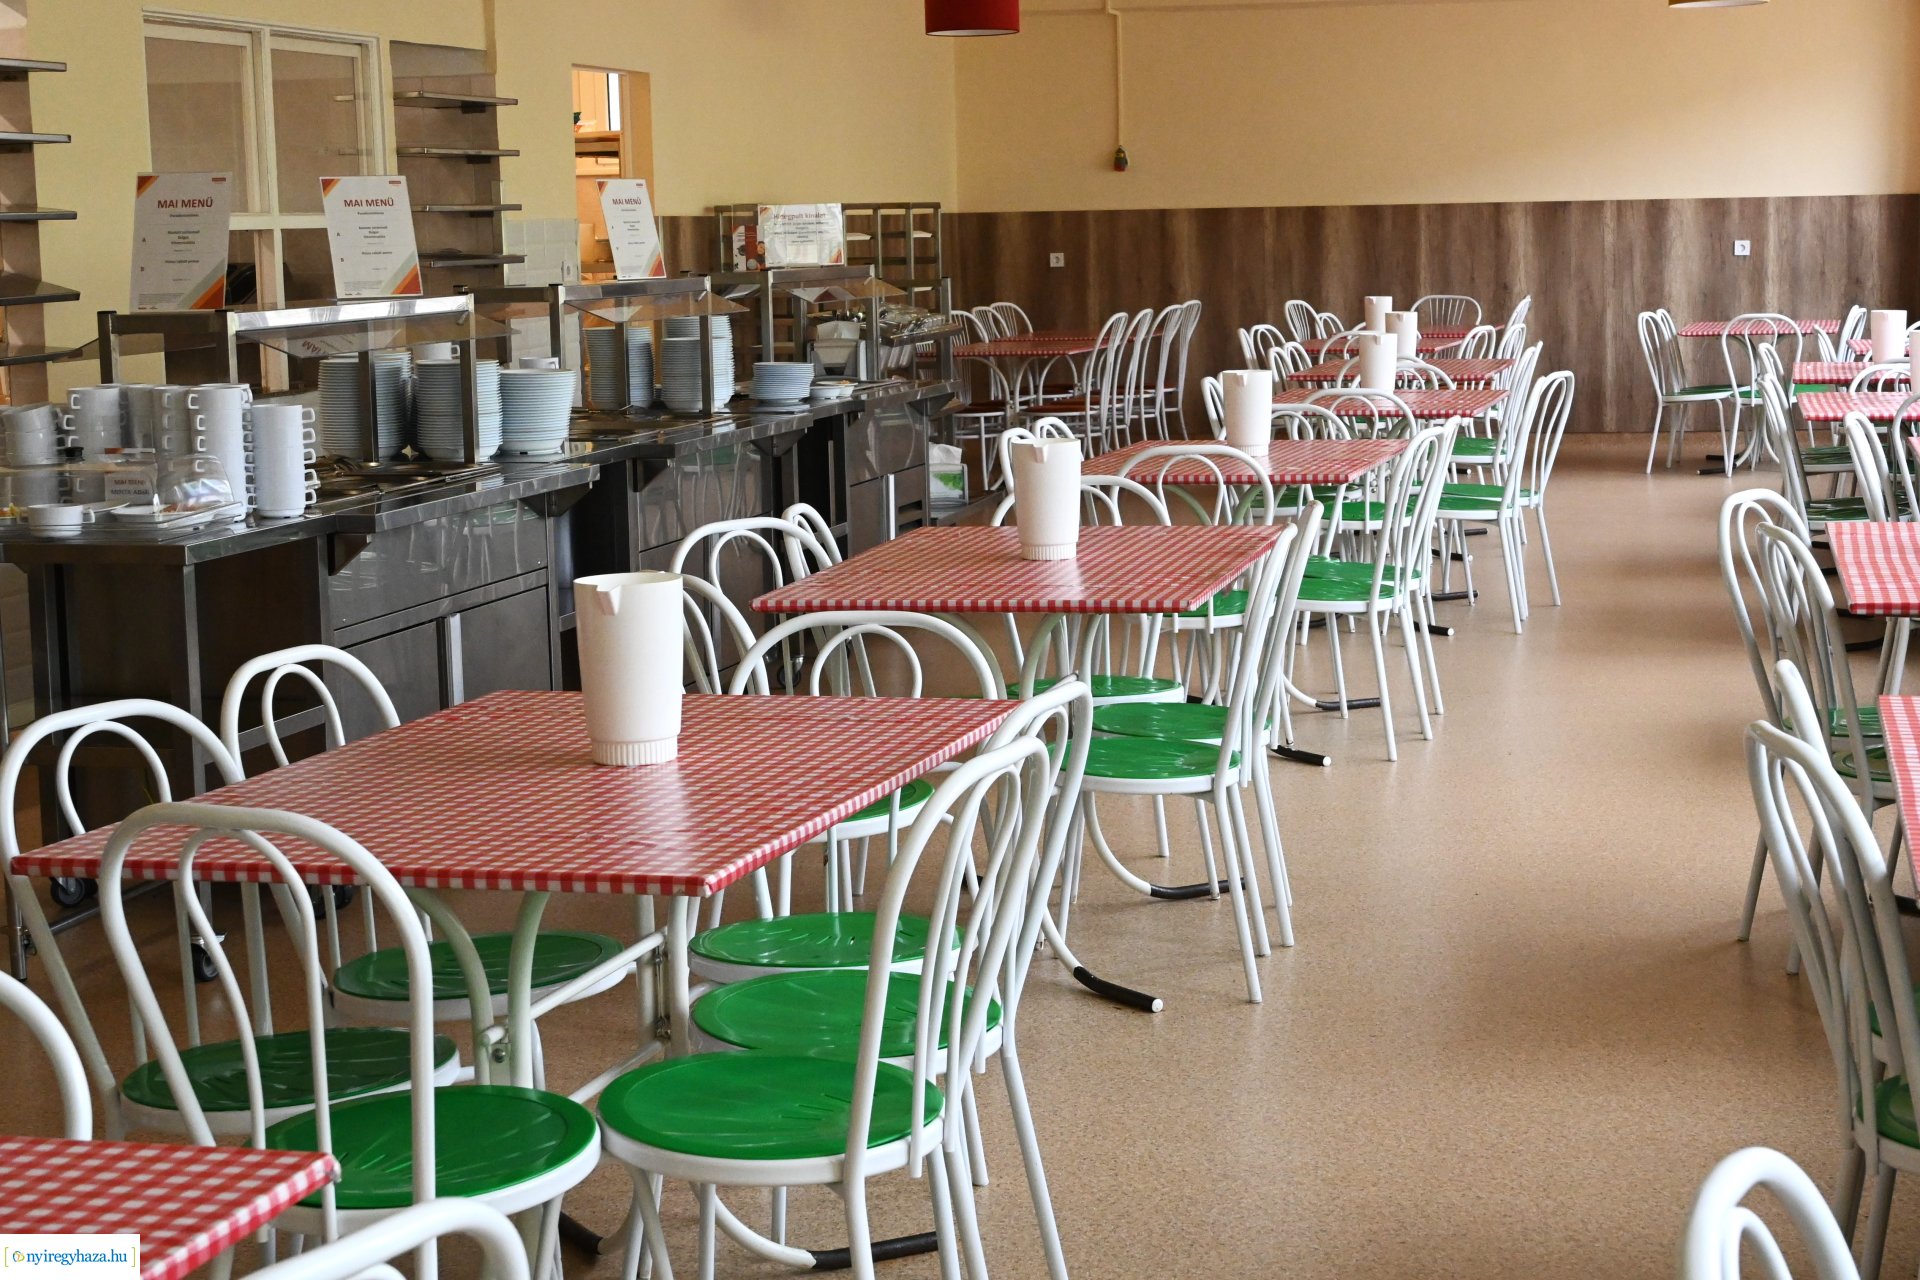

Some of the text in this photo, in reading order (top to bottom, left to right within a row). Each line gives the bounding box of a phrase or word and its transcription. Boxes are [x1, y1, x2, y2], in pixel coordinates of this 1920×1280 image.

[157, 196, 213, 209] MAI MENÜ
[344, 197, 394, 208] MAI MENÜ
